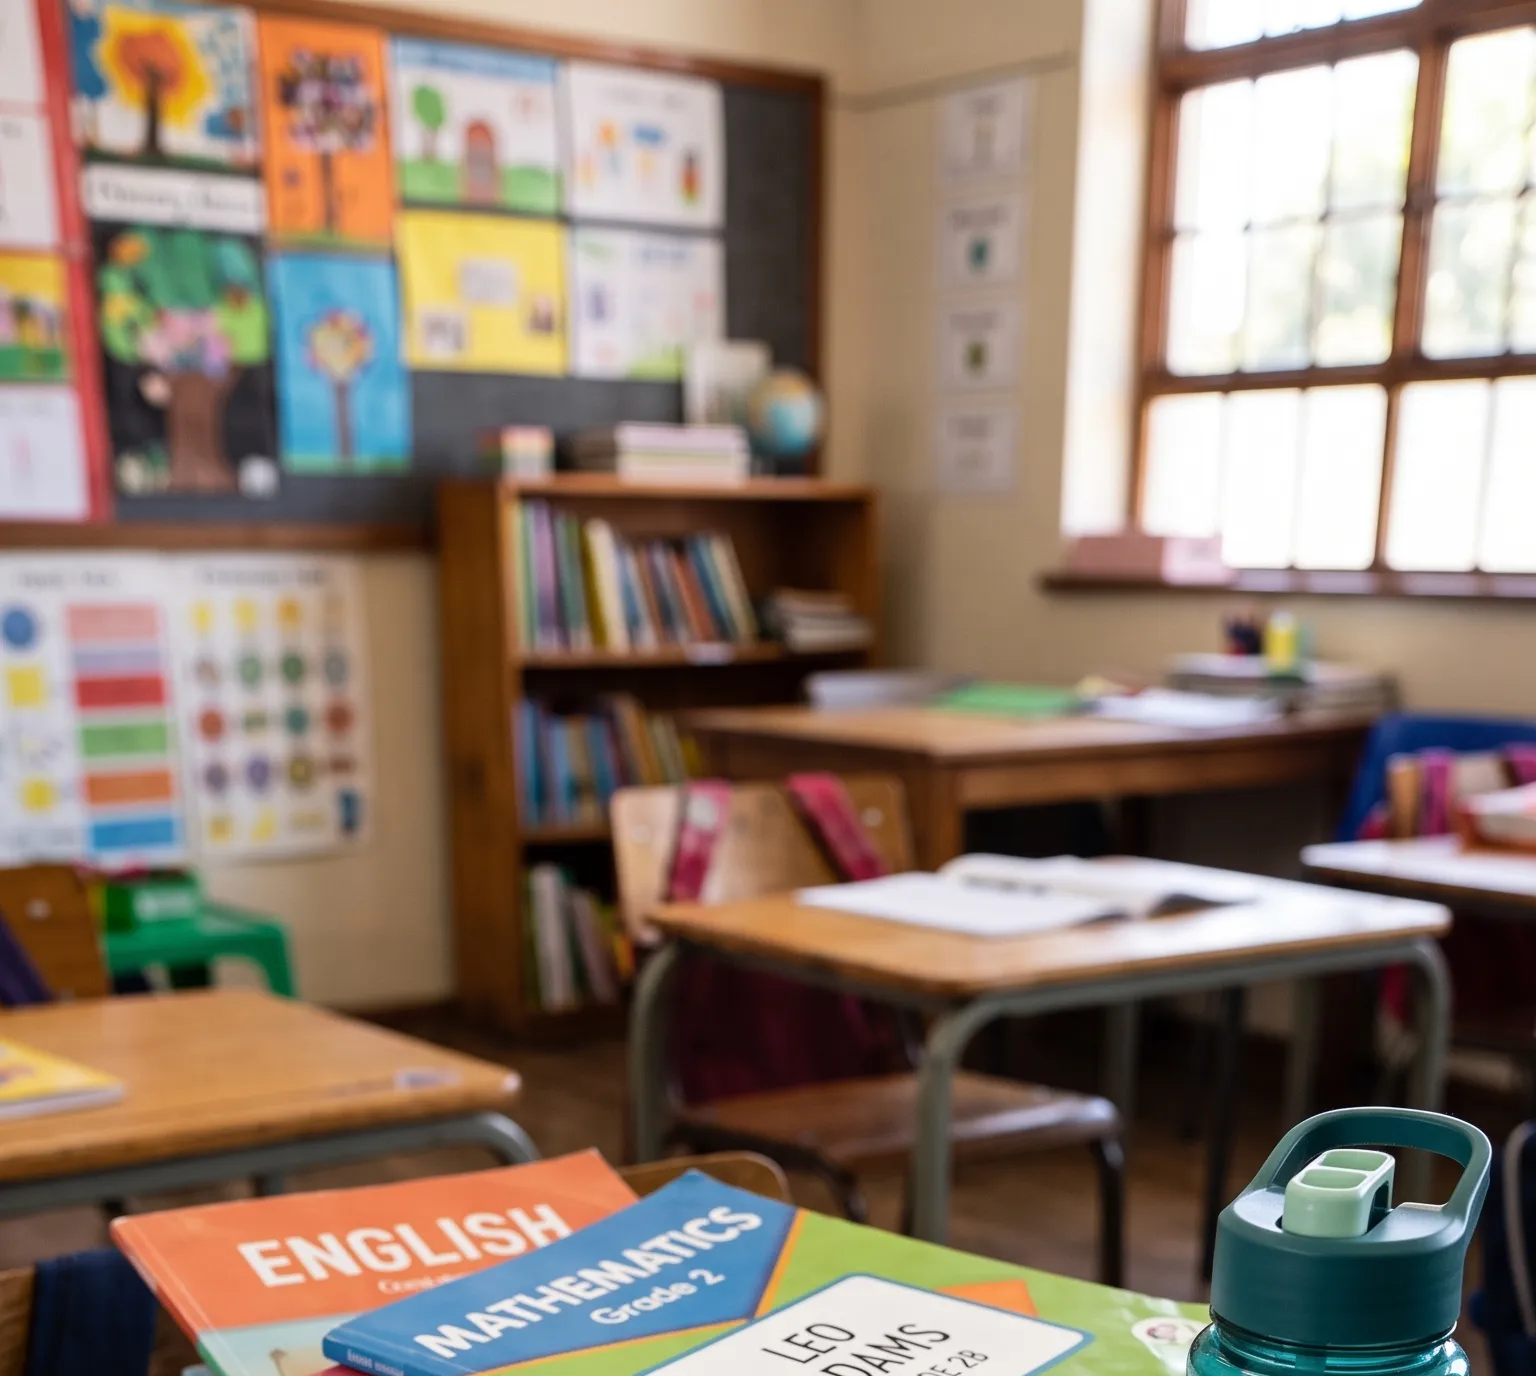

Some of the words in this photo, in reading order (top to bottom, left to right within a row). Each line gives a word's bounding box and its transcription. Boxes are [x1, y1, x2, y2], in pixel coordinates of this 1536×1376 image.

[237, 1203, 573, 1288] ENGLISH
[413, 1205, 763, 1359] MATHEMATICS
[688, 1268, 727, 1287] 2
[761, 1323, 856, 1364] LEO
[947, 1349, 989, 1369] 2B
